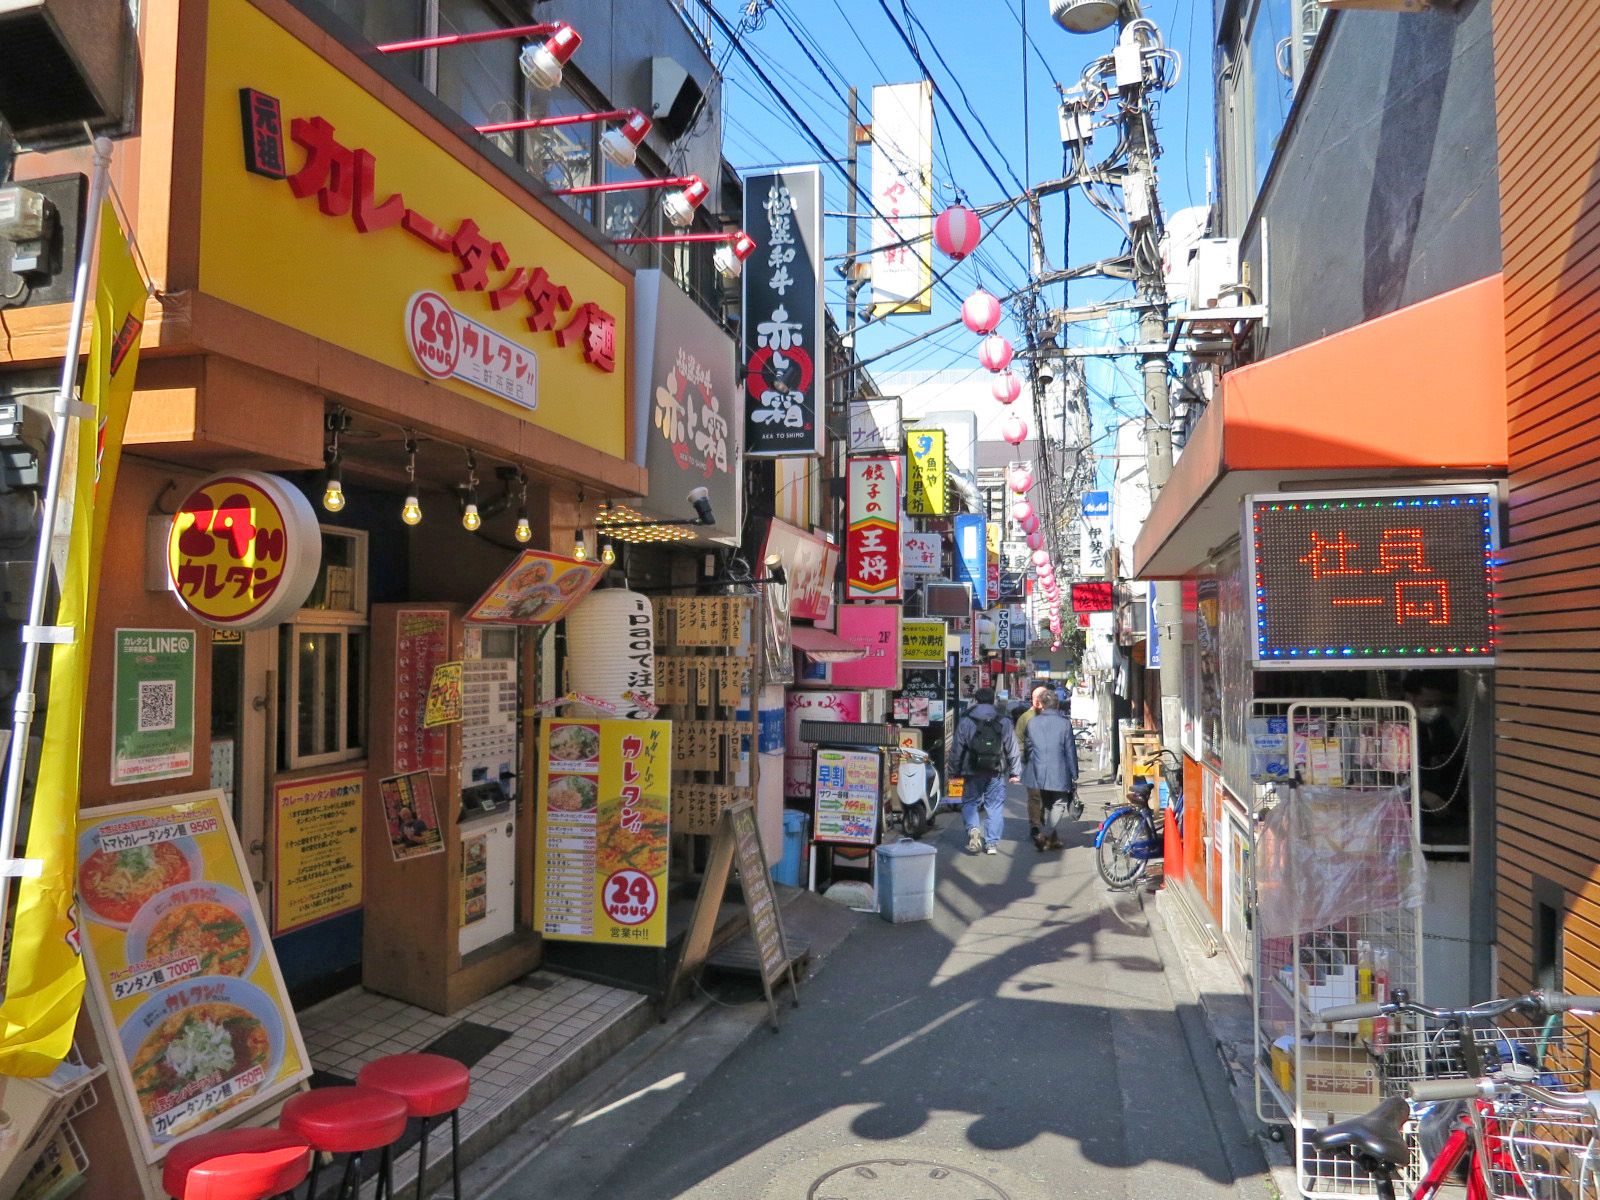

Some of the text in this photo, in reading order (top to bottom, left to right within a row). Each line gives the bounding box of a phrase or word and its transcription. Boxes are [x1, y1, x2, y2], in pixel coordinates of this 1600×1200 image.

[287, 115, 616, 373] カレータンタン麺
[420, 301, 453, 350] 24
[417, 340, 452, 366] HOUR
[852, 427, 892, 443] ナイル
[861, 465, 885, 513] 餃子の
[912, 465, 924, 513] 次男坊
[926, 457, 938, 487] 魚や
[858, 529, 889, 581] 王将
[1089, 527, 1103, 568] 伊勢元
[1299, 528, 1433, 579] 社員
[178, 559, 282, 599] カレタン
[1331, 579, 1449, 625] 一同
[149, 637, 190, 653] LINE@
[878, 631, 891, 643] 2F
[818, 765, 845, 787] 早割
[102, 818, 217, 851] トマトカレータンタン麺 950円
[609, 903, 649, 917] HOUR
[611, 876, 650, 904] 24
[115, 958, 199, 998] タンタン麺 700円
[156, 1066, 264, 1132] カレータンタン麺 750円
